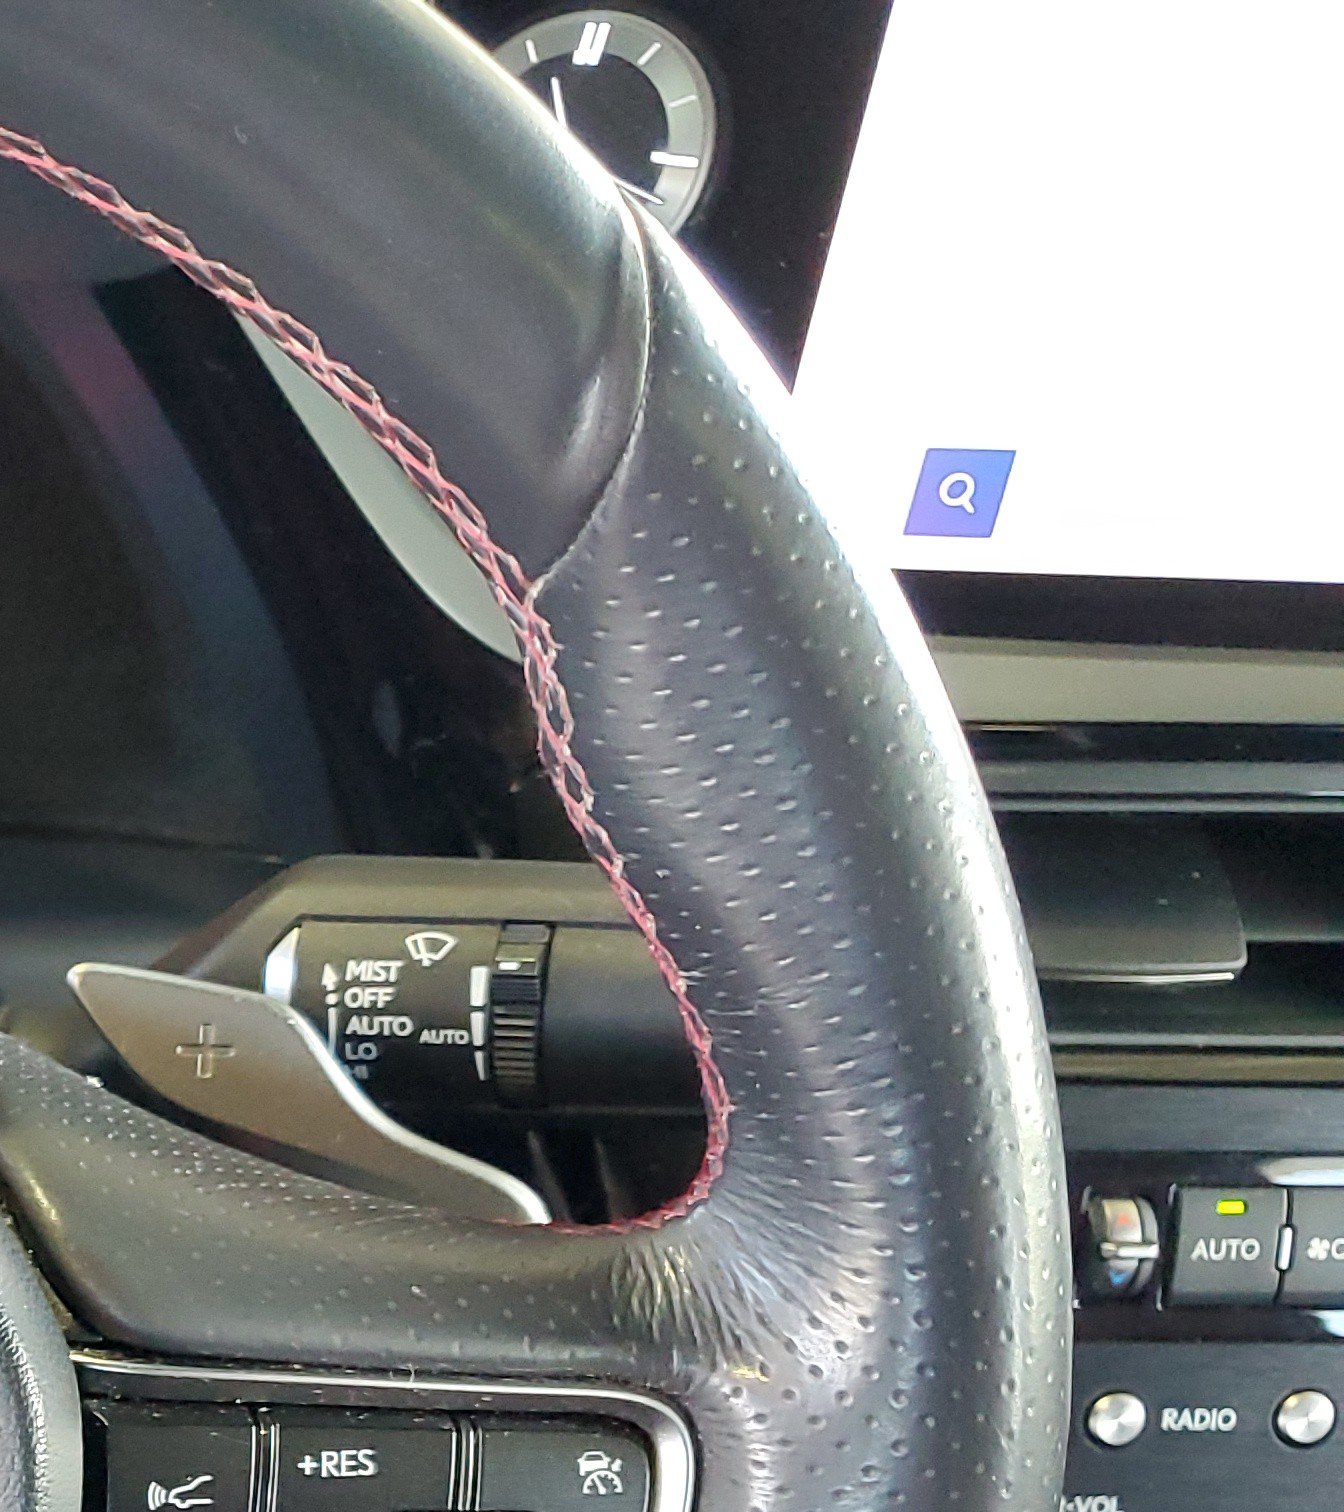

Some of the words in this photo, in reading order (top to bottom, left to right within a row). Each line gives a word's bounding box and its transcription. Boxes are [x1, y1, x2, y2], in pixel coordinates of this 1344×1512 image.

[345, 960, 405, 982] MIST
[344, 986, 395, 1009] OFF
[345, 1015, 414, 1037] AUTO
[419, 1029, 470, 1045] AUTO
[345, 1042, 378, 1060] LO
[1190, 1238, 1261, 1261] AUTO
[1160, 1407, 1237, 1432] RADIO
